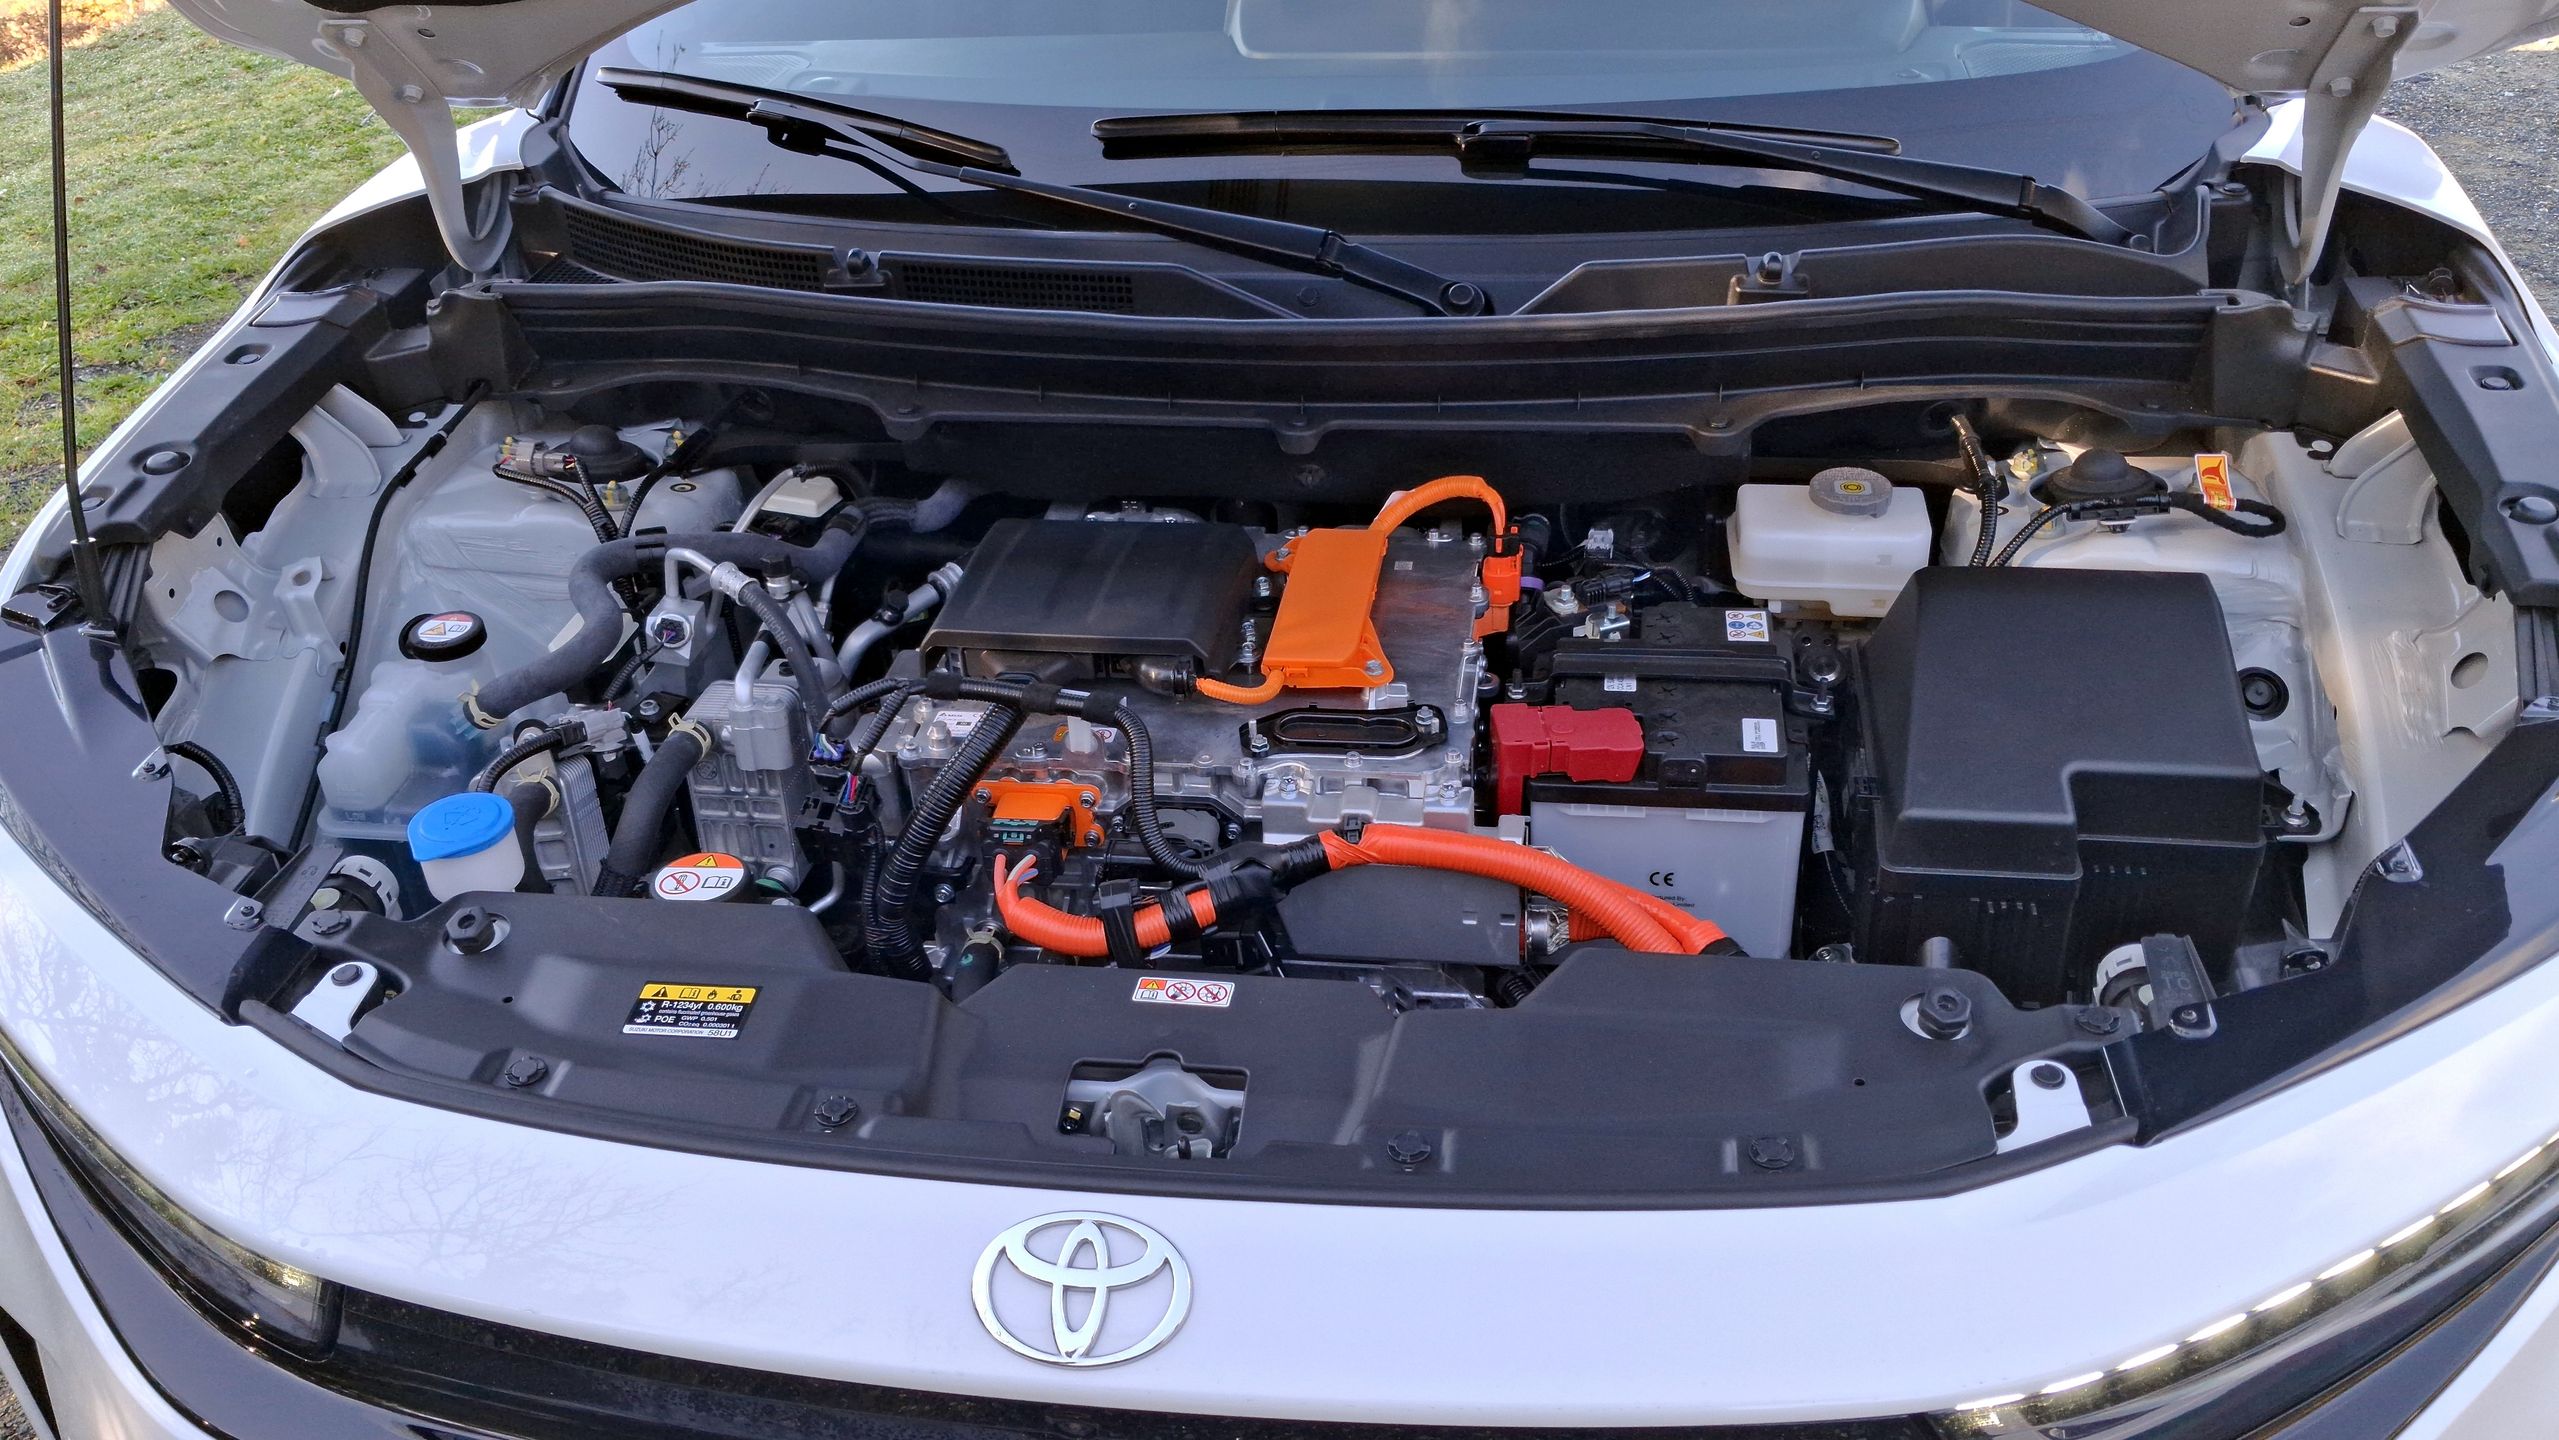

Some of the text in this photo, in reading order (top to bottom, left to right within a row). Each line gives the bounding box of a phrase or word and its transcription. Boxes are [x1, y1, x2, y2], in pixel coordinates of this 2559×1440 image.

[1649, 872, 1674, 887] CE
[661, 1001, 743, 1012] R-1234yf 0.600kg
[653, 1015, 676, 1023] POE
